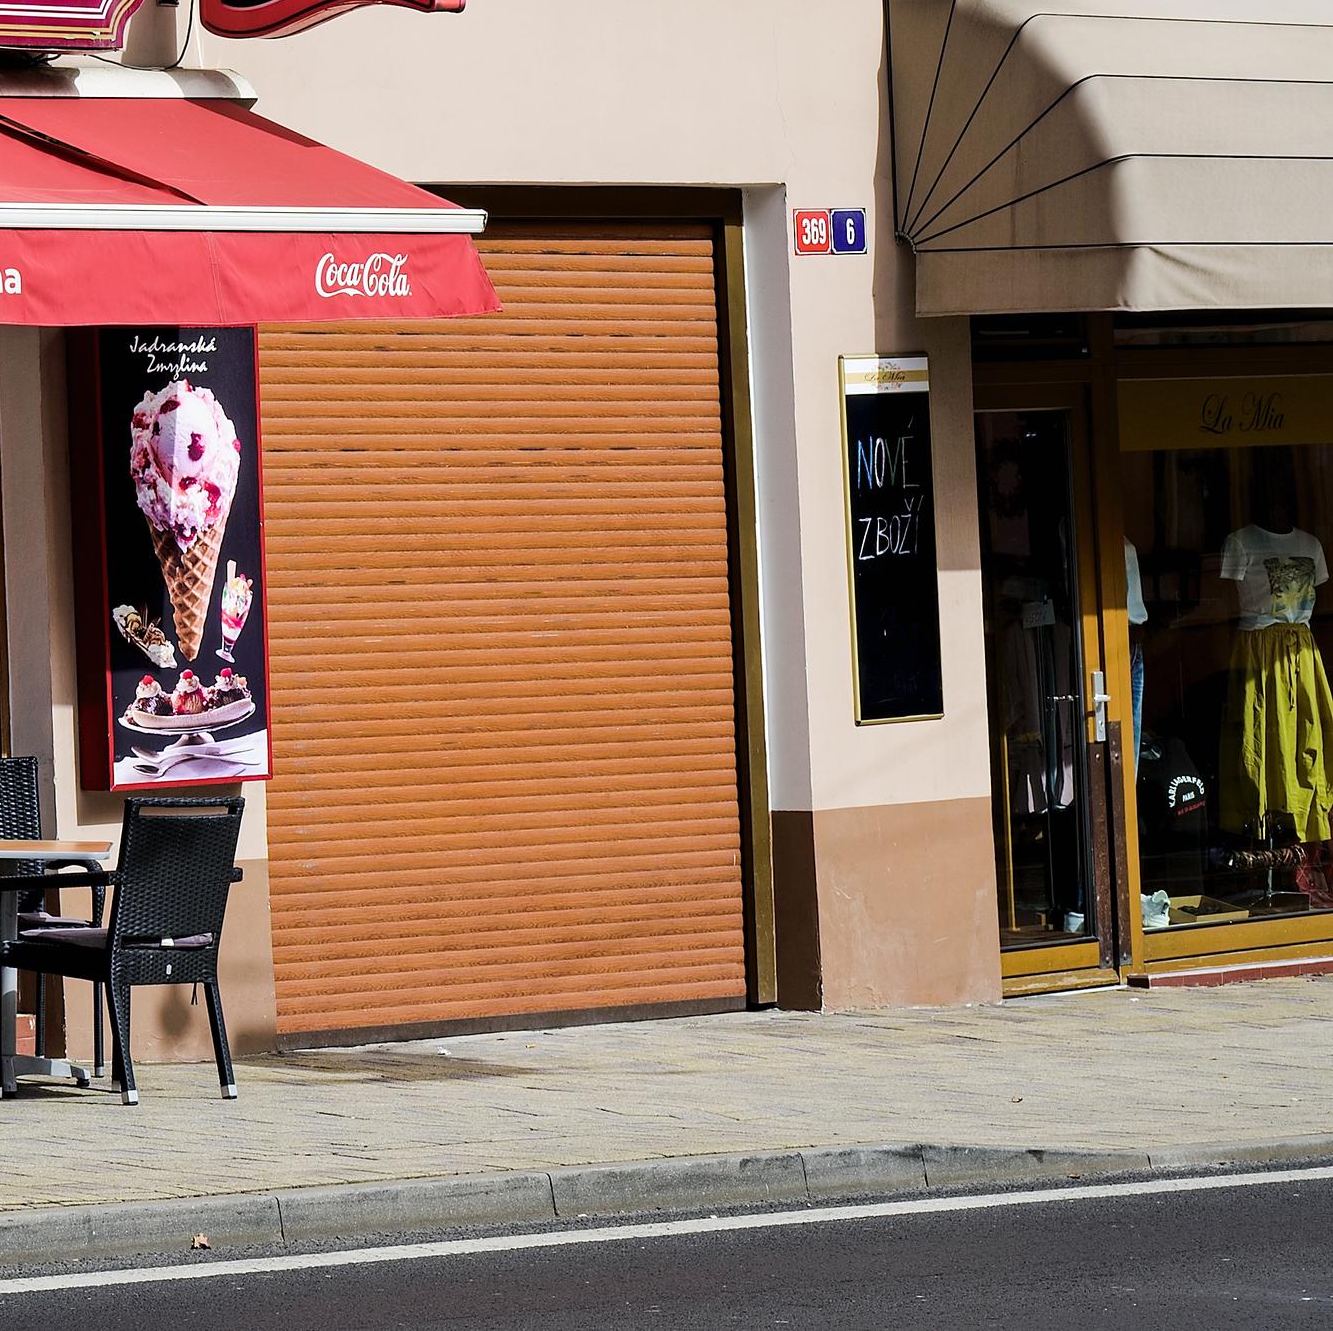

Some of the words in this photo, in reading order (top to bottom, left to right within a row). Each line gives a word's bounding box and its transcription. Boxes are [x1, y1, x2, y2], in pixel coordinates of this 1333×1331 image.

[801, 217, 827, 245] 369
[845, 217, 856, 245] 6
[315, 253, 410, 298] Coca-Cola
[129, 335, 218, 353] Jadranská
[146, 353, 209, 381] Zmrzlina
[1199, 393, 1232, 435] La
[1238, 391, 1286, 432] Mia
[857, 415, 921, 490] NOVÉ
[857, 494, 925, 561] ZBOŽÍ
